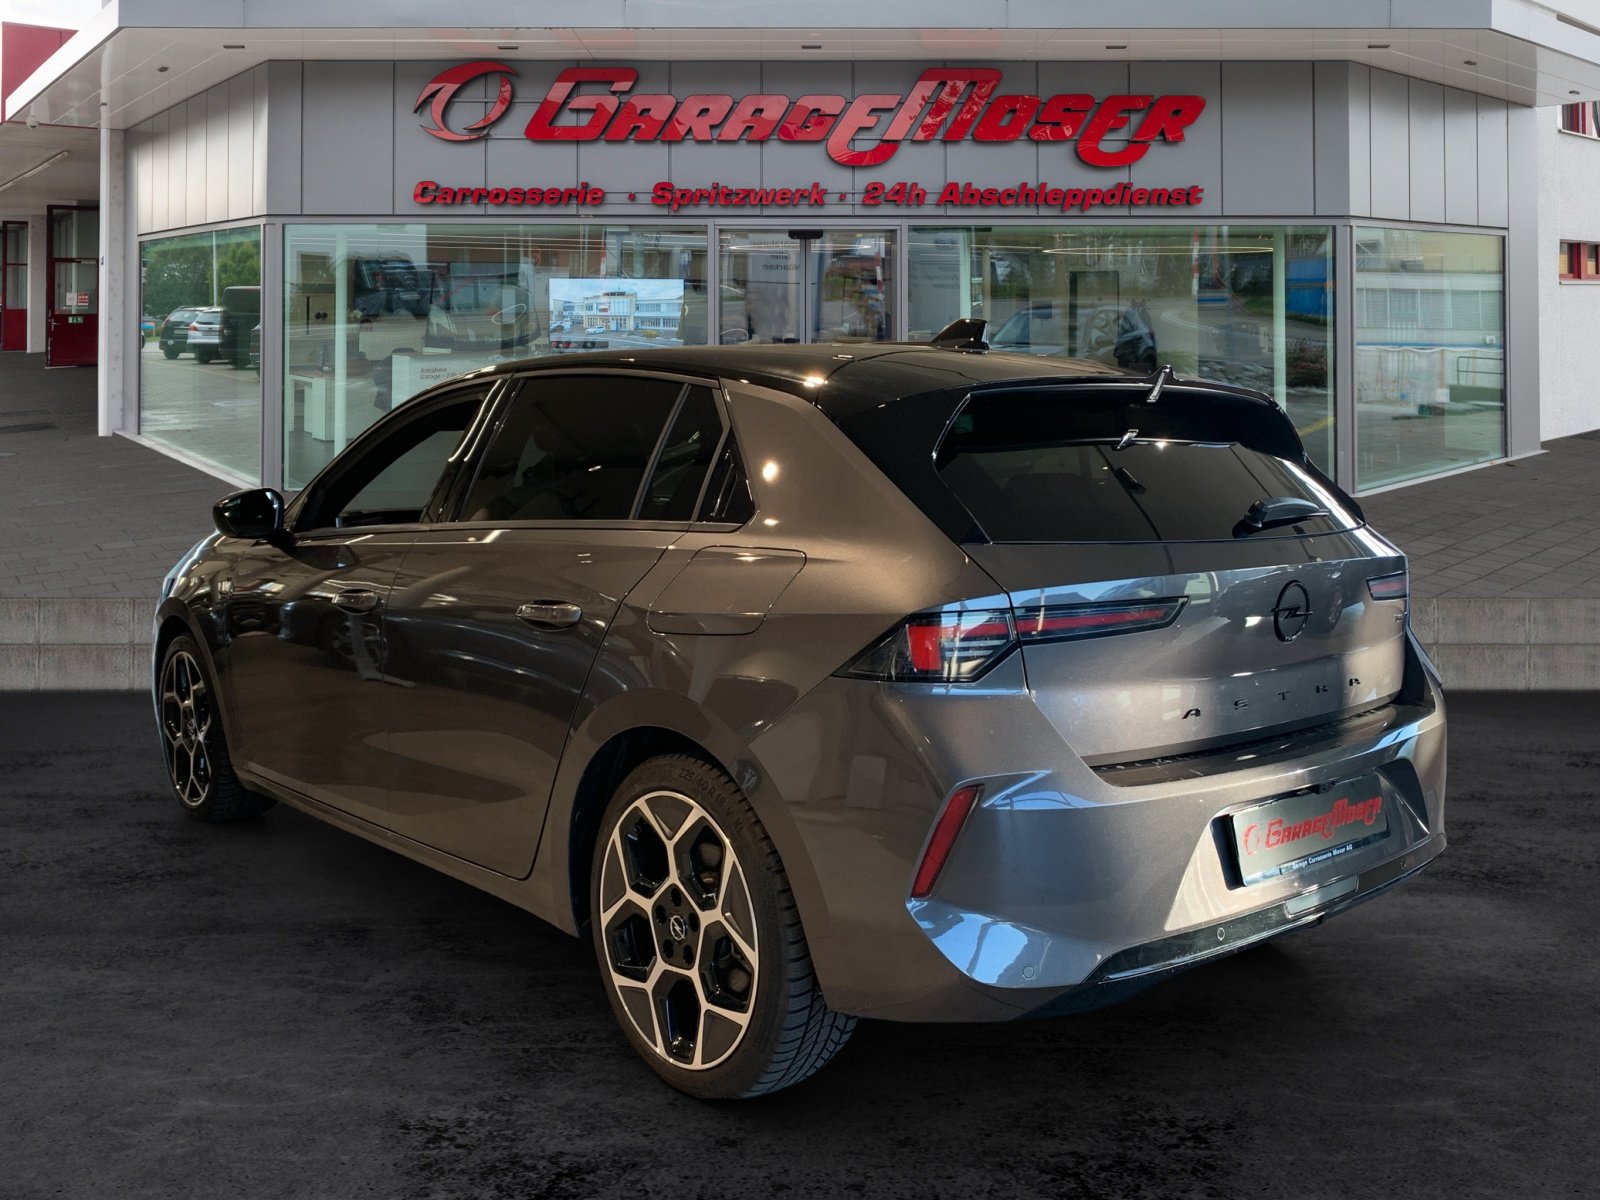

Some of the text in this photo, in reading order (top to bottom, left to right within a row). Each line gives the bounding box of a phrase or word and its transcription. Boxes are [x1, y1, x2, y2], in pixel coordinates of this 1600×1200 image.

[413, 180, 1205, 212] Carrosserie Spritzwerk 24h Abschleppdienst
[1181, 677, 1362, 720] ASTRA
